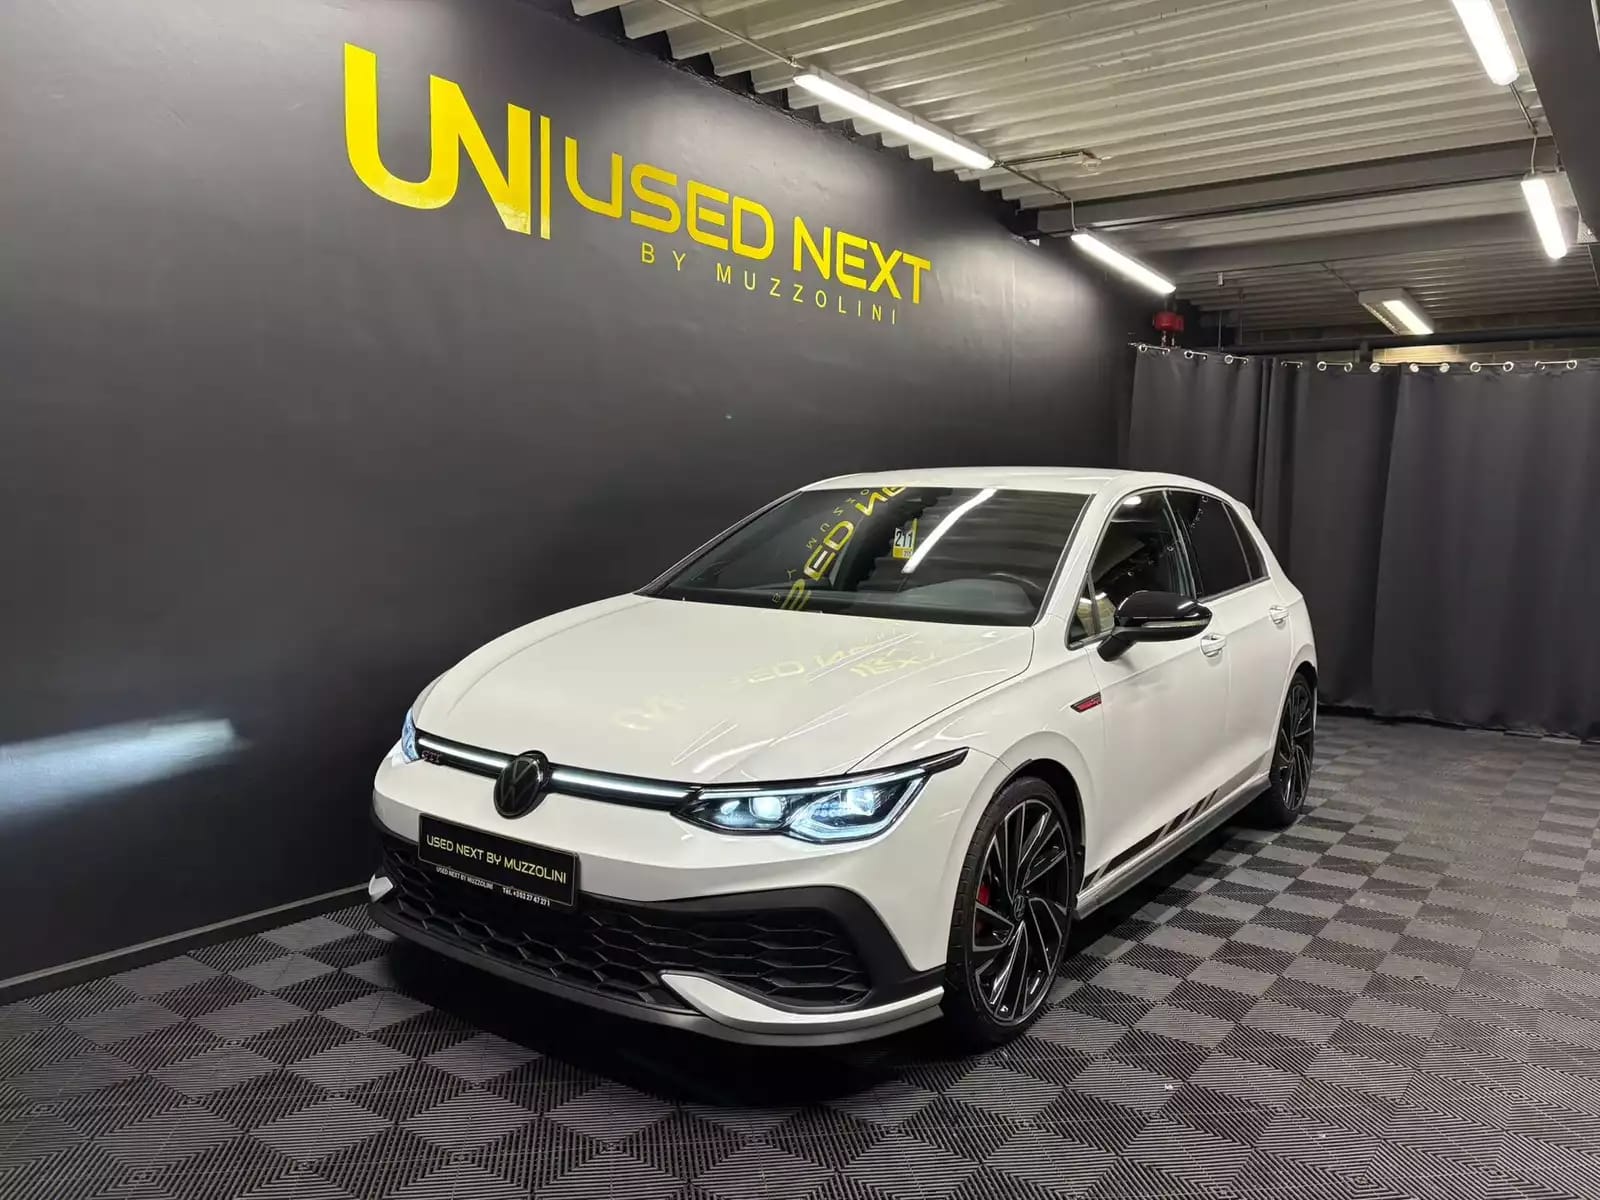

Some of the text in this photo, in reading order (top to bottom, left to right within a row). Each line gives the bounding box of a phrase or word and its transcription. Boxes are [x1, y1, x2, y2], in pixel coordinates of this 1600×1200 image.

[565, 136, 931, 304] USED NEXT
[641, 242, 896, 325] BY MUZZOLINI
[895, 530, 914, 548] 211
[426, 834, 567, 884] USED NEXT BY MUZZOLINI
[449, 870, 460, 880] NEXT
